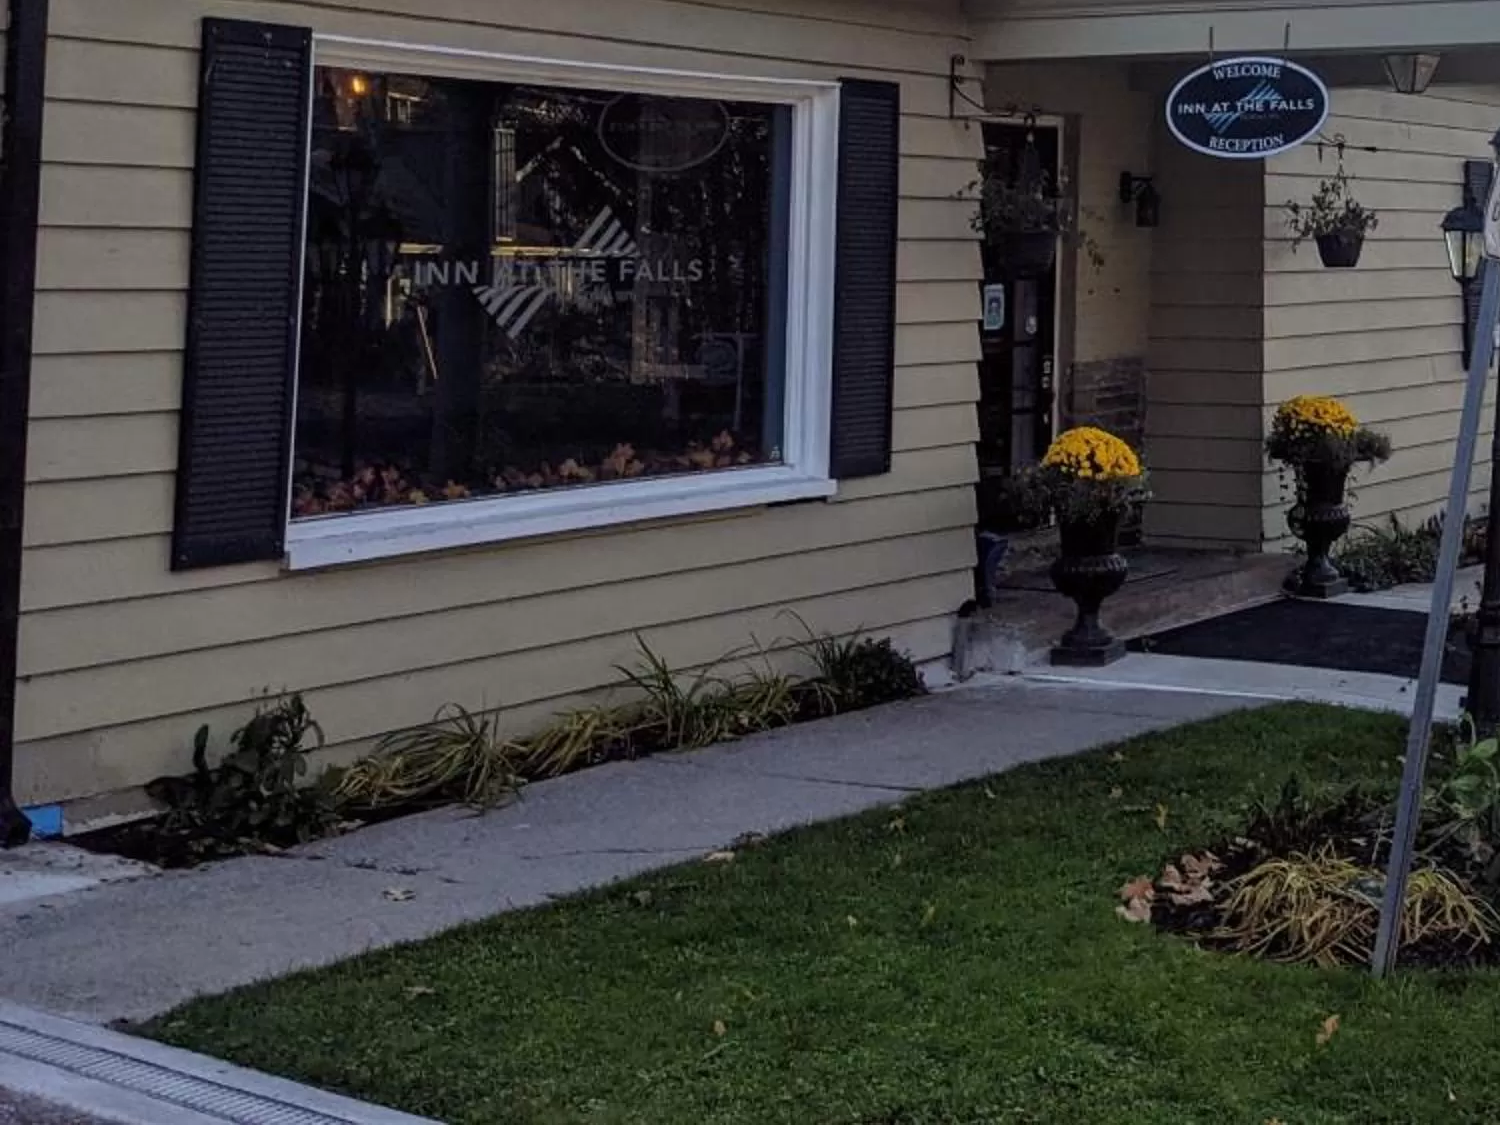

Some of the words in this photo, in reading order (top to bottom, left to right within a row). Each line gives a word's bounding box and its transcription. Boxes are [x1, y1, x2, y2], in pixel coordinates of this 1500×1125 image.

[1213, 64, 1281, 80] WELCOME
[1178, 101, 1206, 115] INN
[1211, 101, 1231, 114] AT
[1236, 100, 1264, 112] THE
[1271, 98, 1315, 111] FALLS
[1209, 133, 1284, 152] RECEPTION
[414, 260, 478, 285] INN
[619, 258, 703, 282] FALLS
